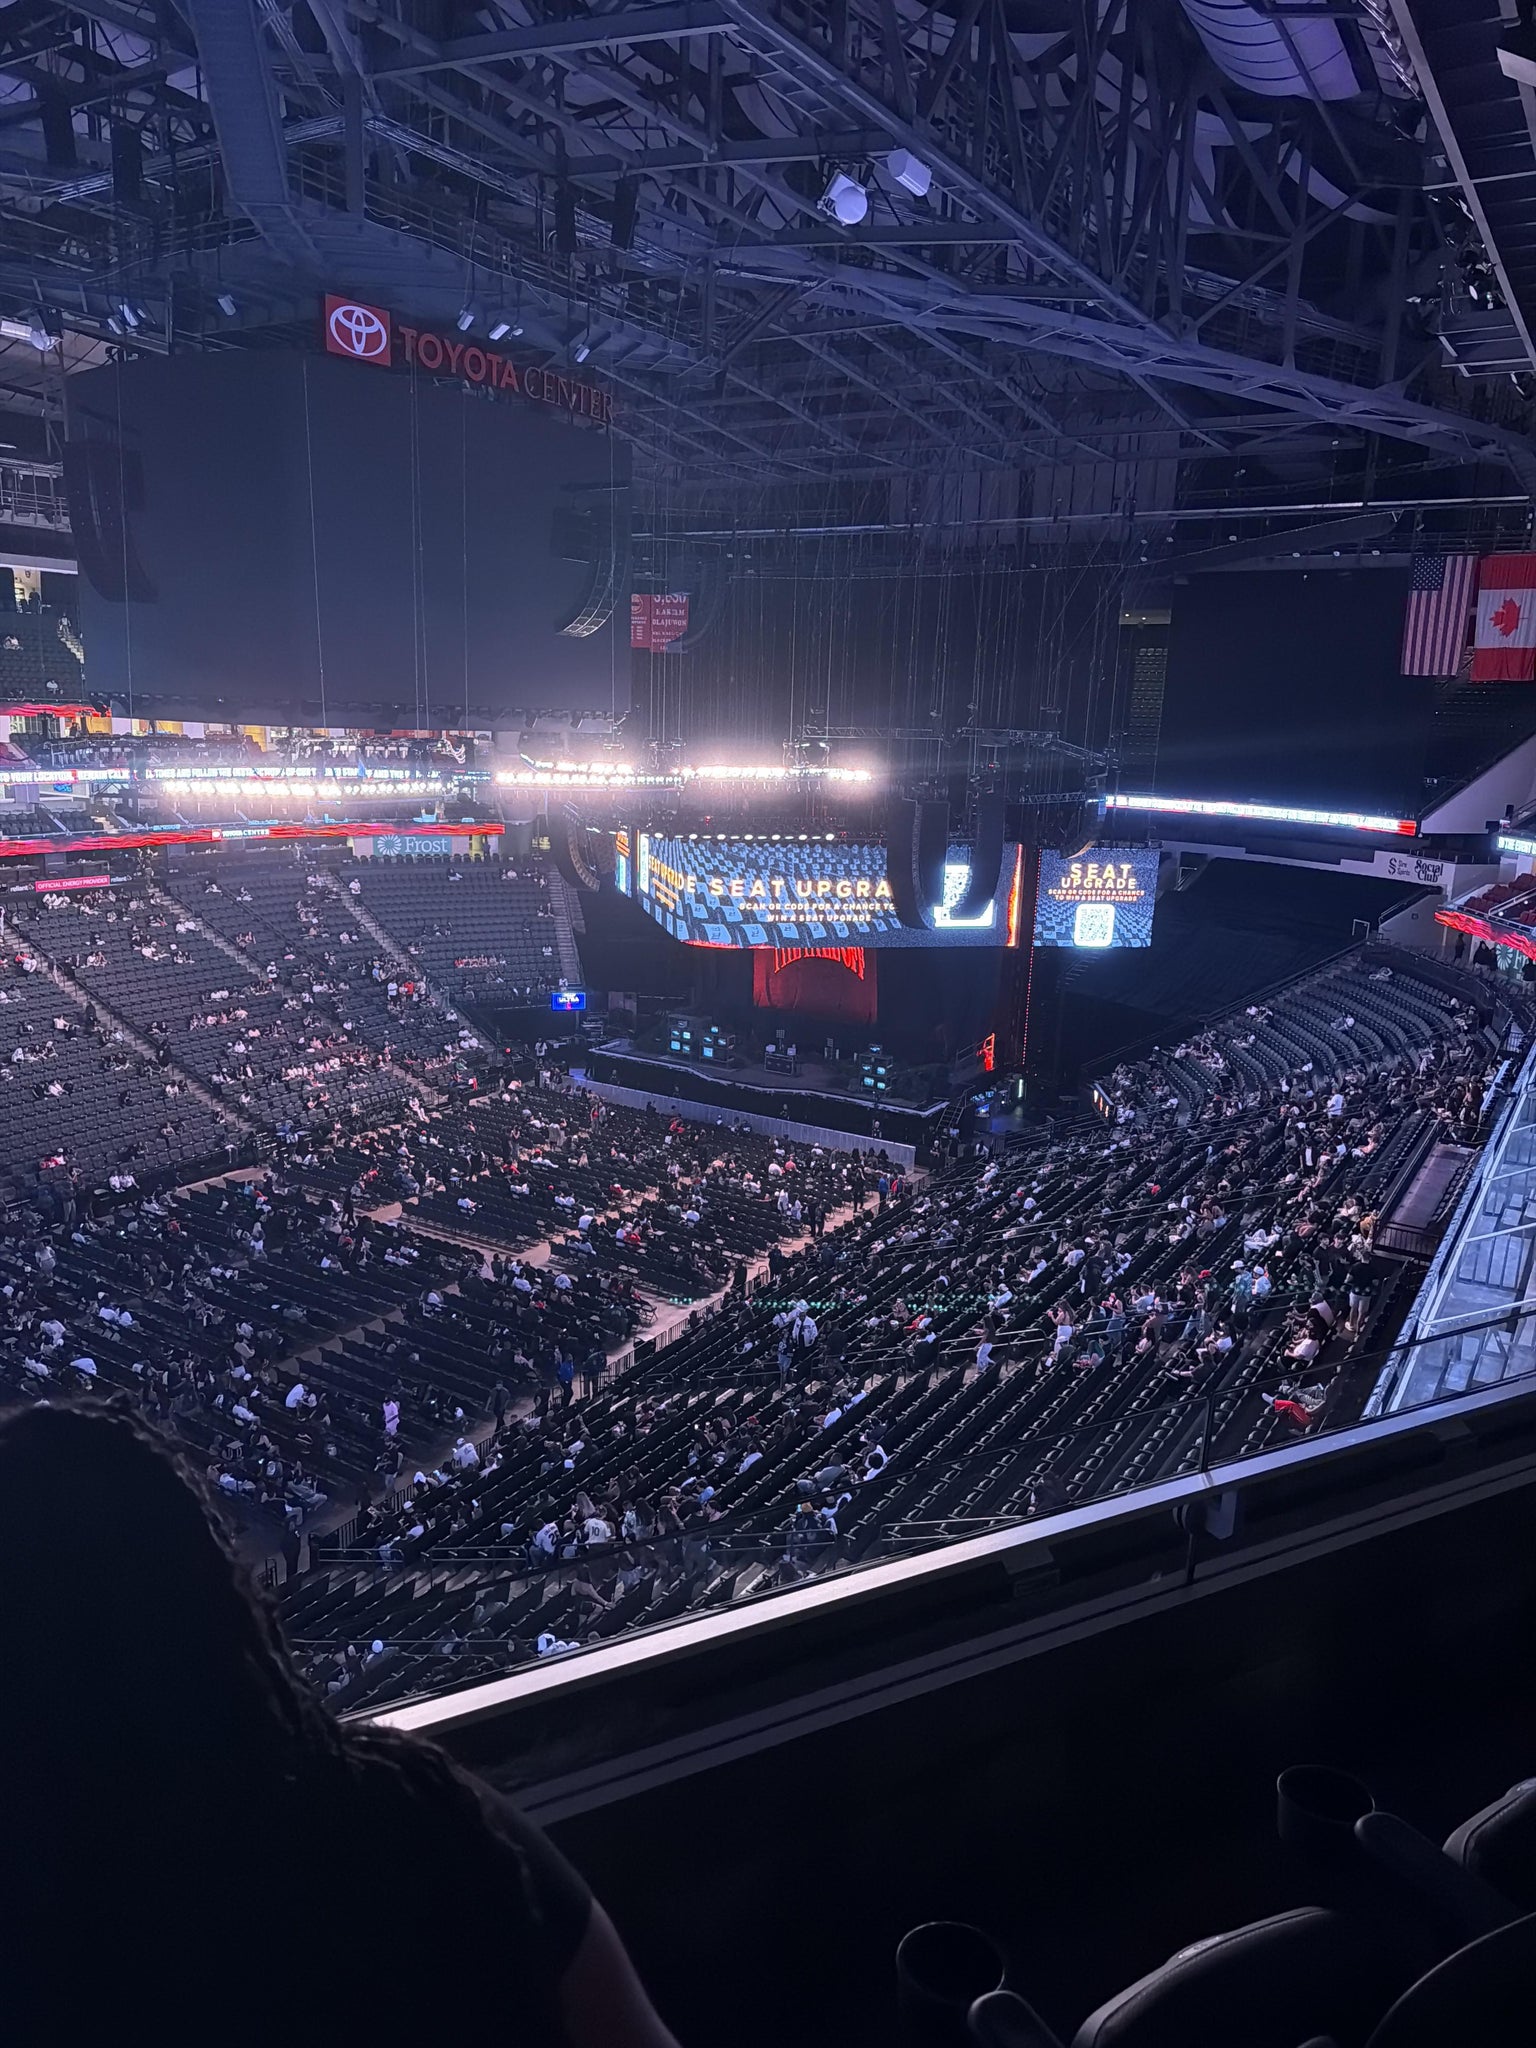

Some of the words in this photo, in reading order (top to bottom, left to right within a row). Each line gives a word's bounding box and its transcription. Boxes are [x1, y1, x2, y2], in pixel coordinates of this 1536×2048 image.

[398, 325, 520, 393] TOYOTA
[524, 366, 614, 424] CENTER
[405, 836, 448, 853] Frost
[1070, 863, 1132, 879] SEAT
[1414, 859, 1443, 876] Social
[1061, 877, 1136, 889] UPGRADE
[1417, 870, 1439, 883] Club
[710, 879, 785, 897] SEAT
[739, 902, 766, 910] SCAN
[843, 902, 880, 911] CHANCE
[591, 1527, 600, 1537] 10
